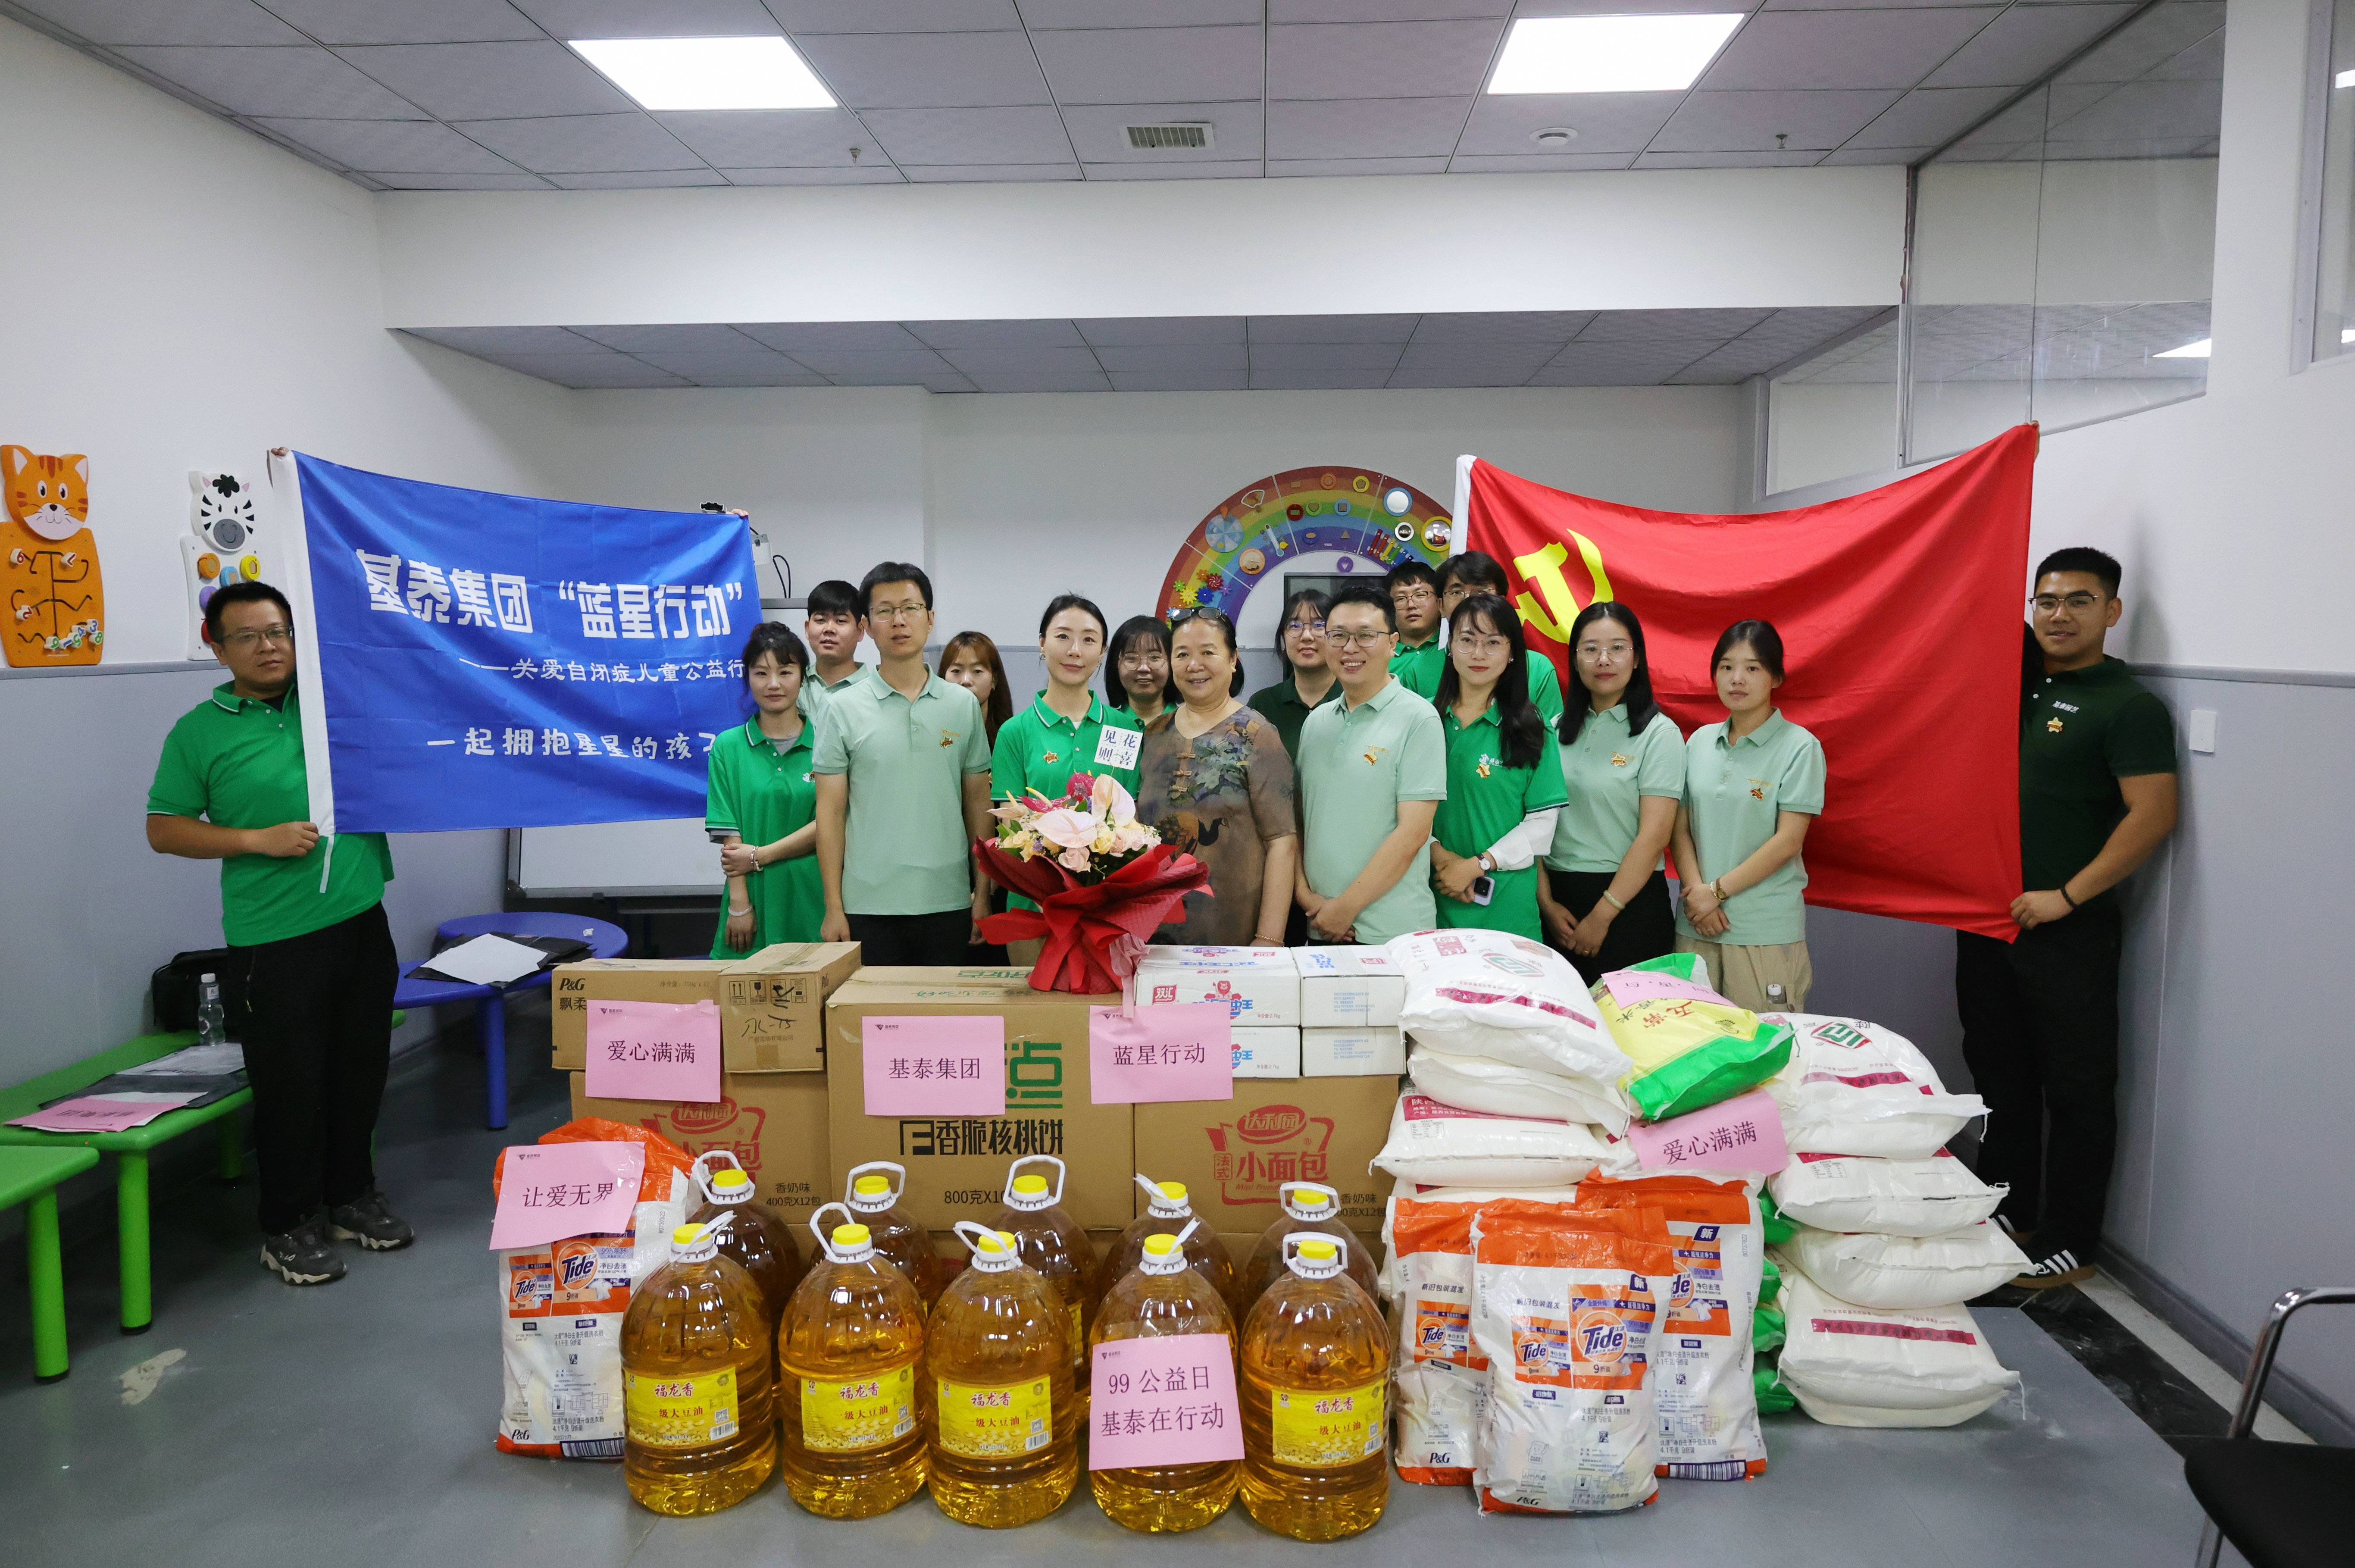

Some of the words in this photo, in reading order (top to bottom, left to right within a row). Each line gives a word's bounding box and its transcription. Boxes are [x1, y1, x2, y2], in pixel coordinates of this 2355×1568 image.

[355, 549, 533, 633] 基泰集团
[559, 580, 743, 639] “蓝星行动”
[560, 978, 586, 991] P&G
[1155, 987, 1174, 999] 双汇
[560, 997, 586, 1011] 飘柔
[607, 1040, 695, 1064] 爱心满满
[1113, 1042, 1205, 1065] 蓝星行动
[888, 1057, 980, 1080] 基泰集团
[1244, 1113, 1300, 1130] 达利园
[1663, 1121, 1757, 1165] 爱心满满
[1216, 1155, 1230, 1179] 法式
[1235, 1151, 1329, 1183] 小面包
[522, 1183, 613, 1208] 让爱无界
[775, 1182, 811, 1193] 香奶味
[766, 1196, 821, 1206] 400克X12包
[1341, 1193, 1377, 1205] 香奶味
[1701, 1228, 1714, 1239] 新
[561, 1255, 594, 1285] Tide
[515, 1279, 535, 1299] Tide
[1421, 1283, 1464, 1293] 新旧包装混发
[1634, 1277, 1645, 1289] 新
[1673, 1274, 1691, 1293] de
[1516, 1298, 1560, 1310] 新旧包装混发
[1423, 1327, 1444, 1344] Tide
[1583, 1326, 1623, 1356] Tide
[1521, 1343, 1546, 1363] Tide
[654, 1382, 693, 1398] 福龙香
[840, 1382, 879, 1400] 福龙香
[971, 1392, 1011, 1406] 福龙香
[1315, 1396, 1354, 1415] 福龙香
[654, 1406, 703, 1418] 一级大豆油
[837, 1405, 888, 1420] 一级大豆油
[1101, 1402, 1223, 1437] 基泰在行动
[970, 1416, 1020, 1427] 一级大豆油
[1314, 1421, 1361, 1435] 一级大豆油
[512, 1429, 530, 1440] P&G
[1429, 1452, 1450, 1464] P&G
